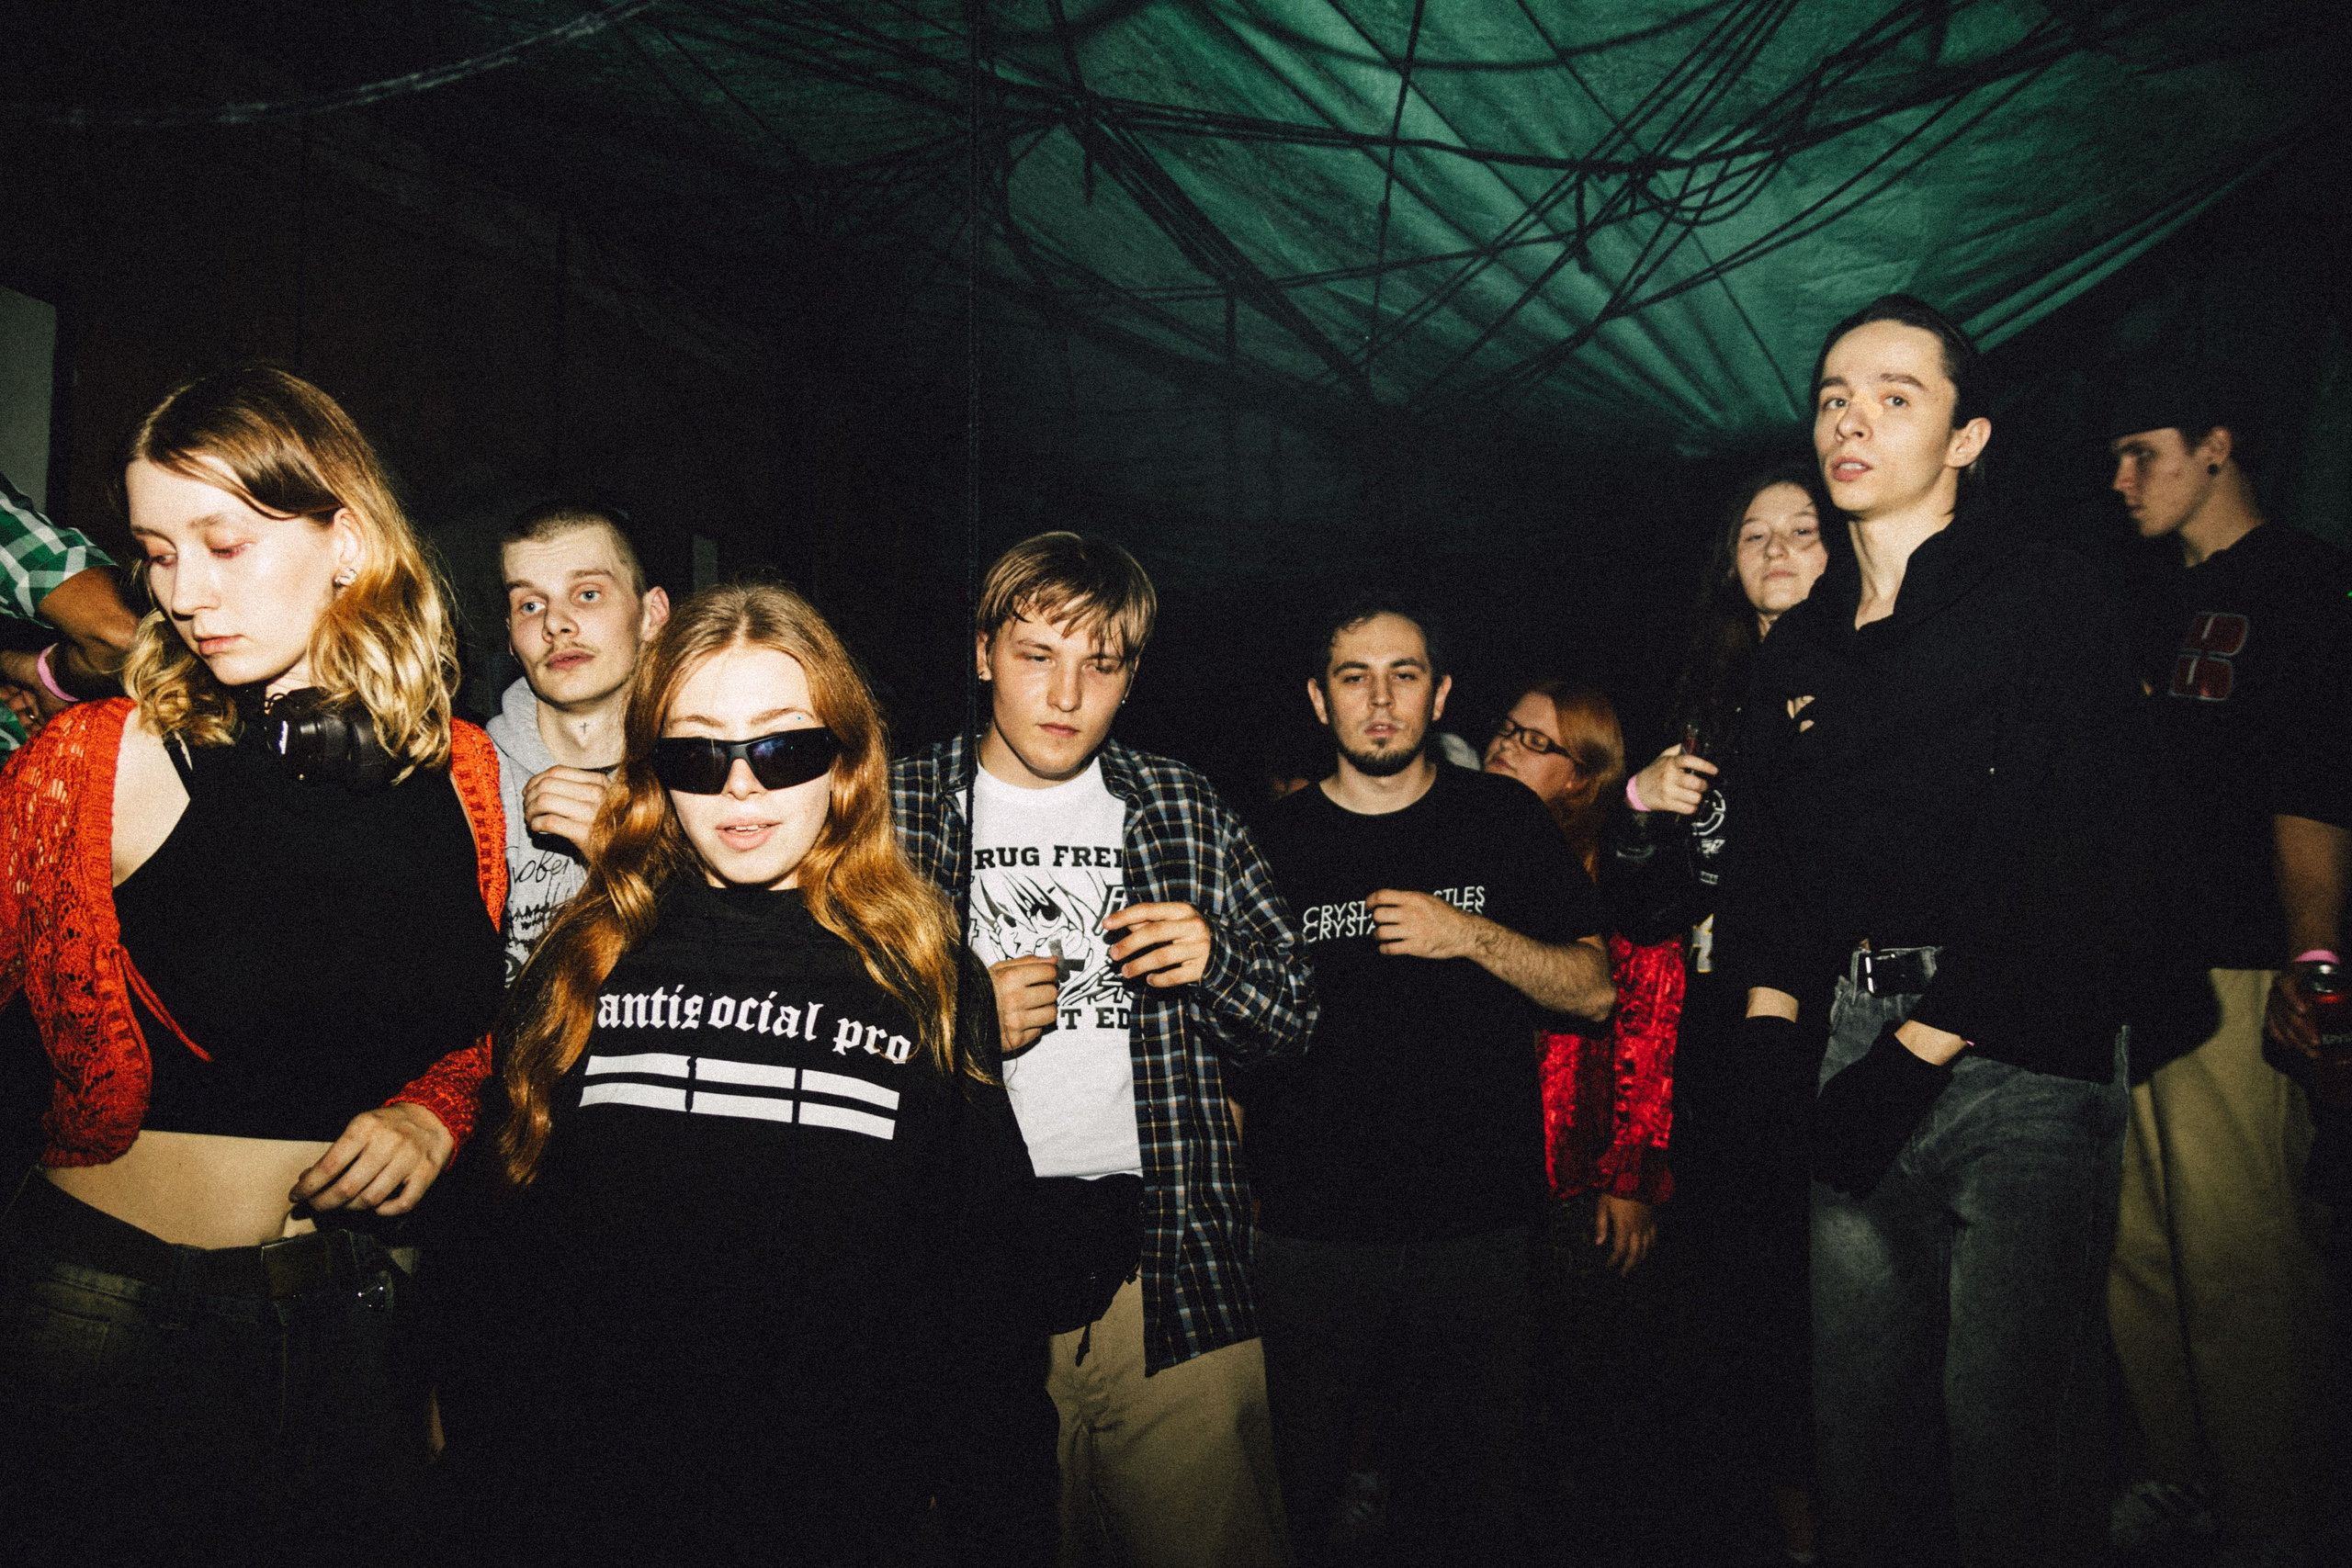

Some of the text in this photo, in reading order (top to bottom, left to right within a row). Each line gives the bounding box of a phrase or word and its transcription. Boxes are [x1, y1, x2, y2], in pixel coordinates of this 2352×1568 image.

[1303, 886, 1486, 922] CRYST TLES
[597, 984, 824, 1042] antisocial
